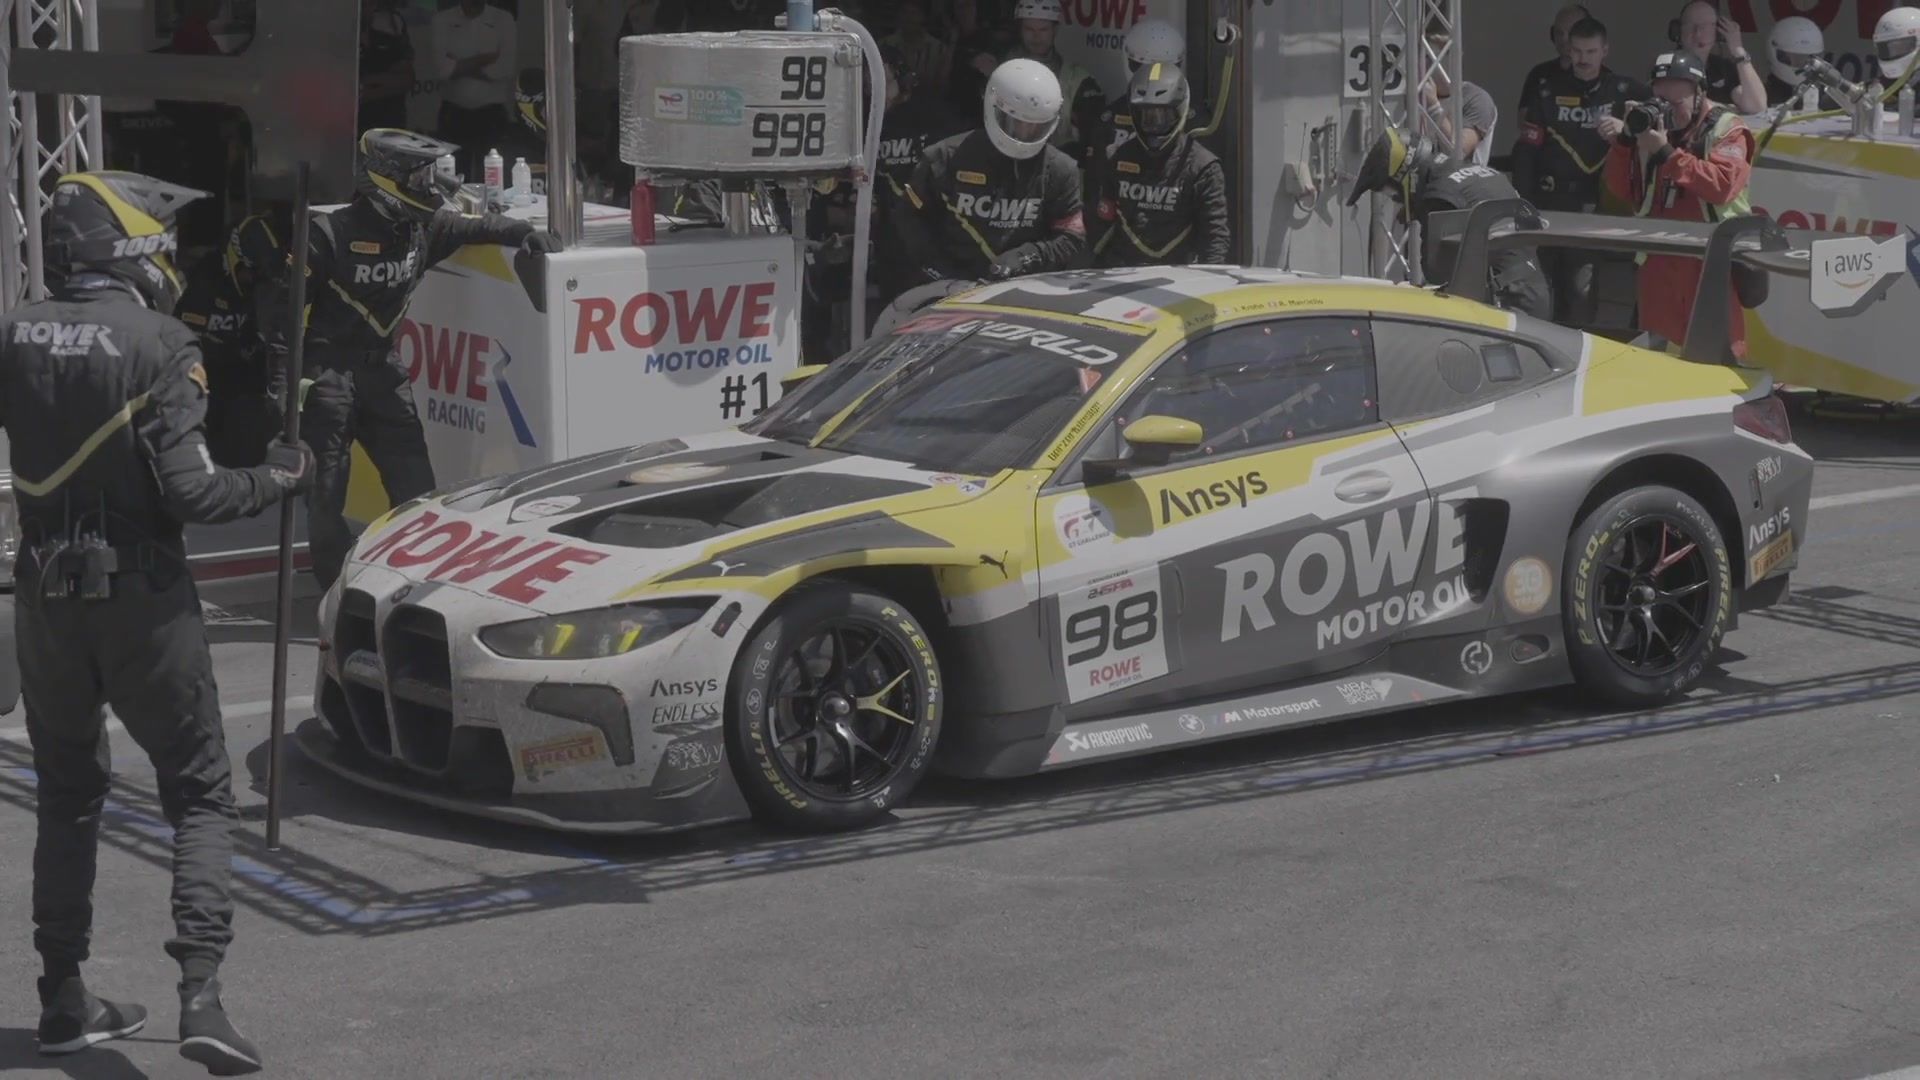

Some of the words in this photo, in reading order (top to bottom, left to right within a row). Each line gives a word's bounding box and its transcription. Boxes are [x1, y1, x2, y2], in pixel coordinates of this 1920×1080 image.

[782, 57, 826, 99] 98
[752, 113, 826, 156] 998
[955, 193, 1041, 221] ROWE
[1118, 181, 1178, 204] ROWE
[113, 234, 176, 257] 100%
[1834, 253, 1873, 274] aws
[13, 321, 99, 346] ROWE
[571, 282, 775, 354] ROWE
[393, 317, 489, 402] OWE
[644, 348, 730, 374] MOTOR
[735, 344, 772, 366] OIL
[427, 397, 486, 434] RACING
[720, 372, 769, 420] #1
[1161, 471, 1268, 525] Ansys
[1749, 506, 1790, 550] Ansys
[361, 511, 611, 604] ROWE
[1214, 486, 1480, 642] ROWE
[1066, 591, 1158, 667] 98
[1317, 589, 1427, 650] MOTOR
[650, 678, 718, 697] Ansys
[1089, 656, 1141, 686] ROWE
[652, 702, 720, 723] ENDLESS
[1243, 697, 1321, 719] Motorsport
